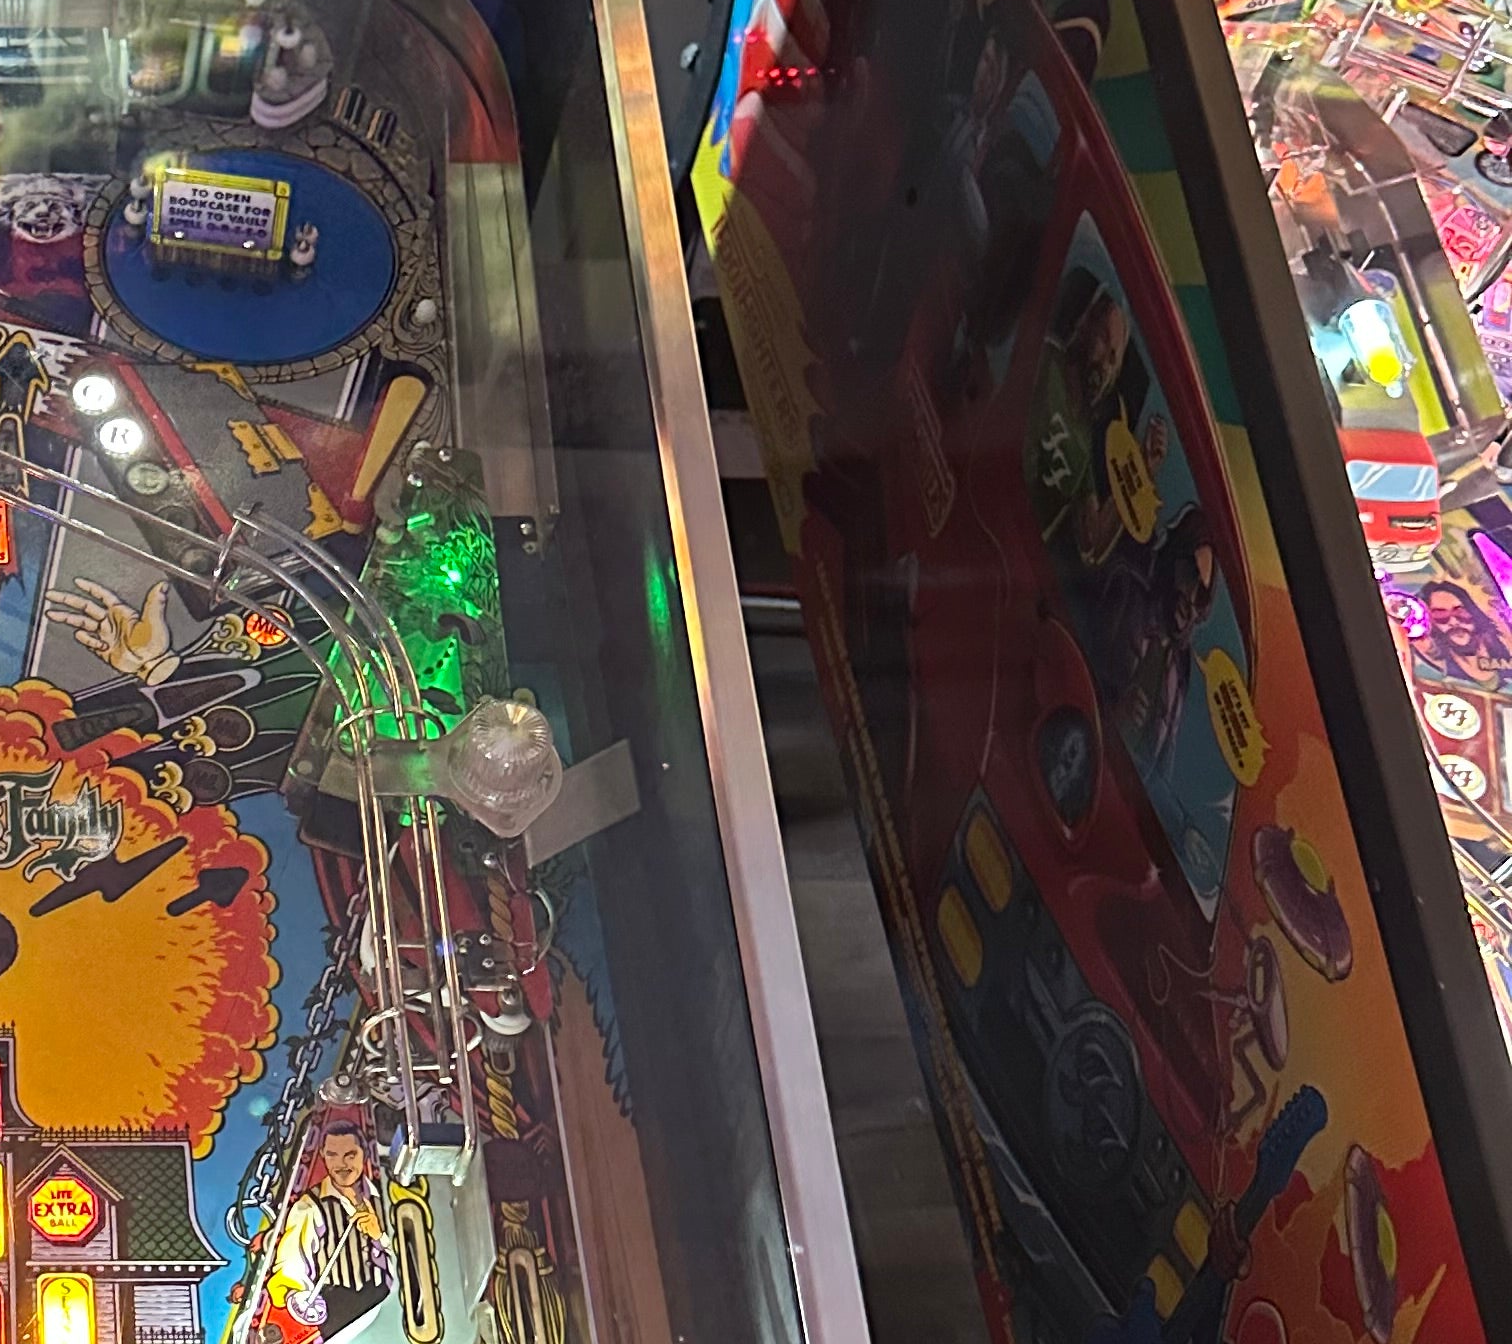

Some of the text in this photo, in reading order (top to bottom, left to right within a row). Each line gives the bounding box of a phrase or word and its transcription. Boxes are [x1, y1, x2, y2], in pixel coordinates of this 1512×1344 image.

[191, 188, 251, 204] TO OPEN
[168, 196, 272, 217] BOOKCASE FOR
[168, 207, 268, 228] SHOT TO VAULT
[168, 217, 202, 230] SPELL
[51, 1190, 73, 1200] LITE
[34, 1202, 92, 1218] EXTRA
[49, 1218, 78, 1228] BALL
